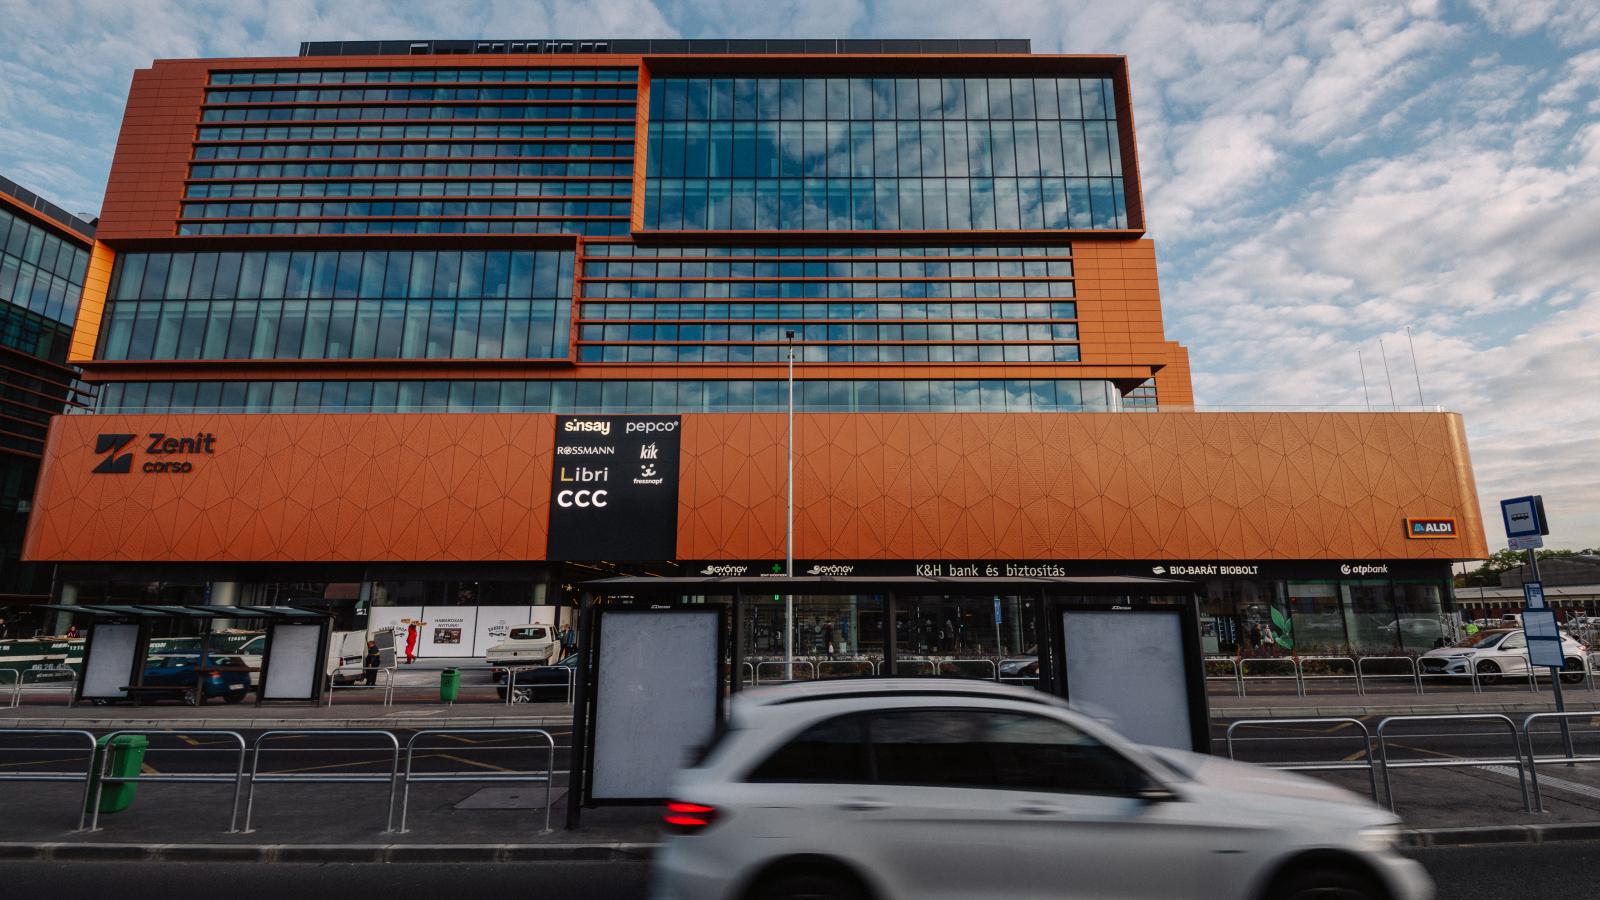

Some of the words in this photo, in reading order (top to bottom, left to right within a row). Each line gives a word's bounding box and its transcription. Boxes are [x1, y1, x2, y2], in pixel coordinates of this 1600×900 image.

[564, 418, 611, 436] sinsay
[146, 432, 216, 454] Zenit
[557, 446, 615, 455] ROSSMANN
[640, 441, 659, 460] kik
[142, 460, 193, 473] corso
[560, 466, 609, 482] Libri
[633, 477, 664, 486] fressnapf
[557, 489, 608, 508] CCC
[1425, 522, 1452, 532] ALDI
[714, 564, 748, 573] GYÖNGY
[820, 564, 854, 573] GYÖNGY
[916, 564, 942, 577] K&H
[949, 563, 979, 577] bank
[986, 564, 999, 577] és
[1006, 563, 1066, 577] biztosítás
[1169, 564, 1218, 575] BIO-BARÁT
[1220, 565, 1259, 575] BIOBOLT
[1352, 563, 1388, 576] otpbank
